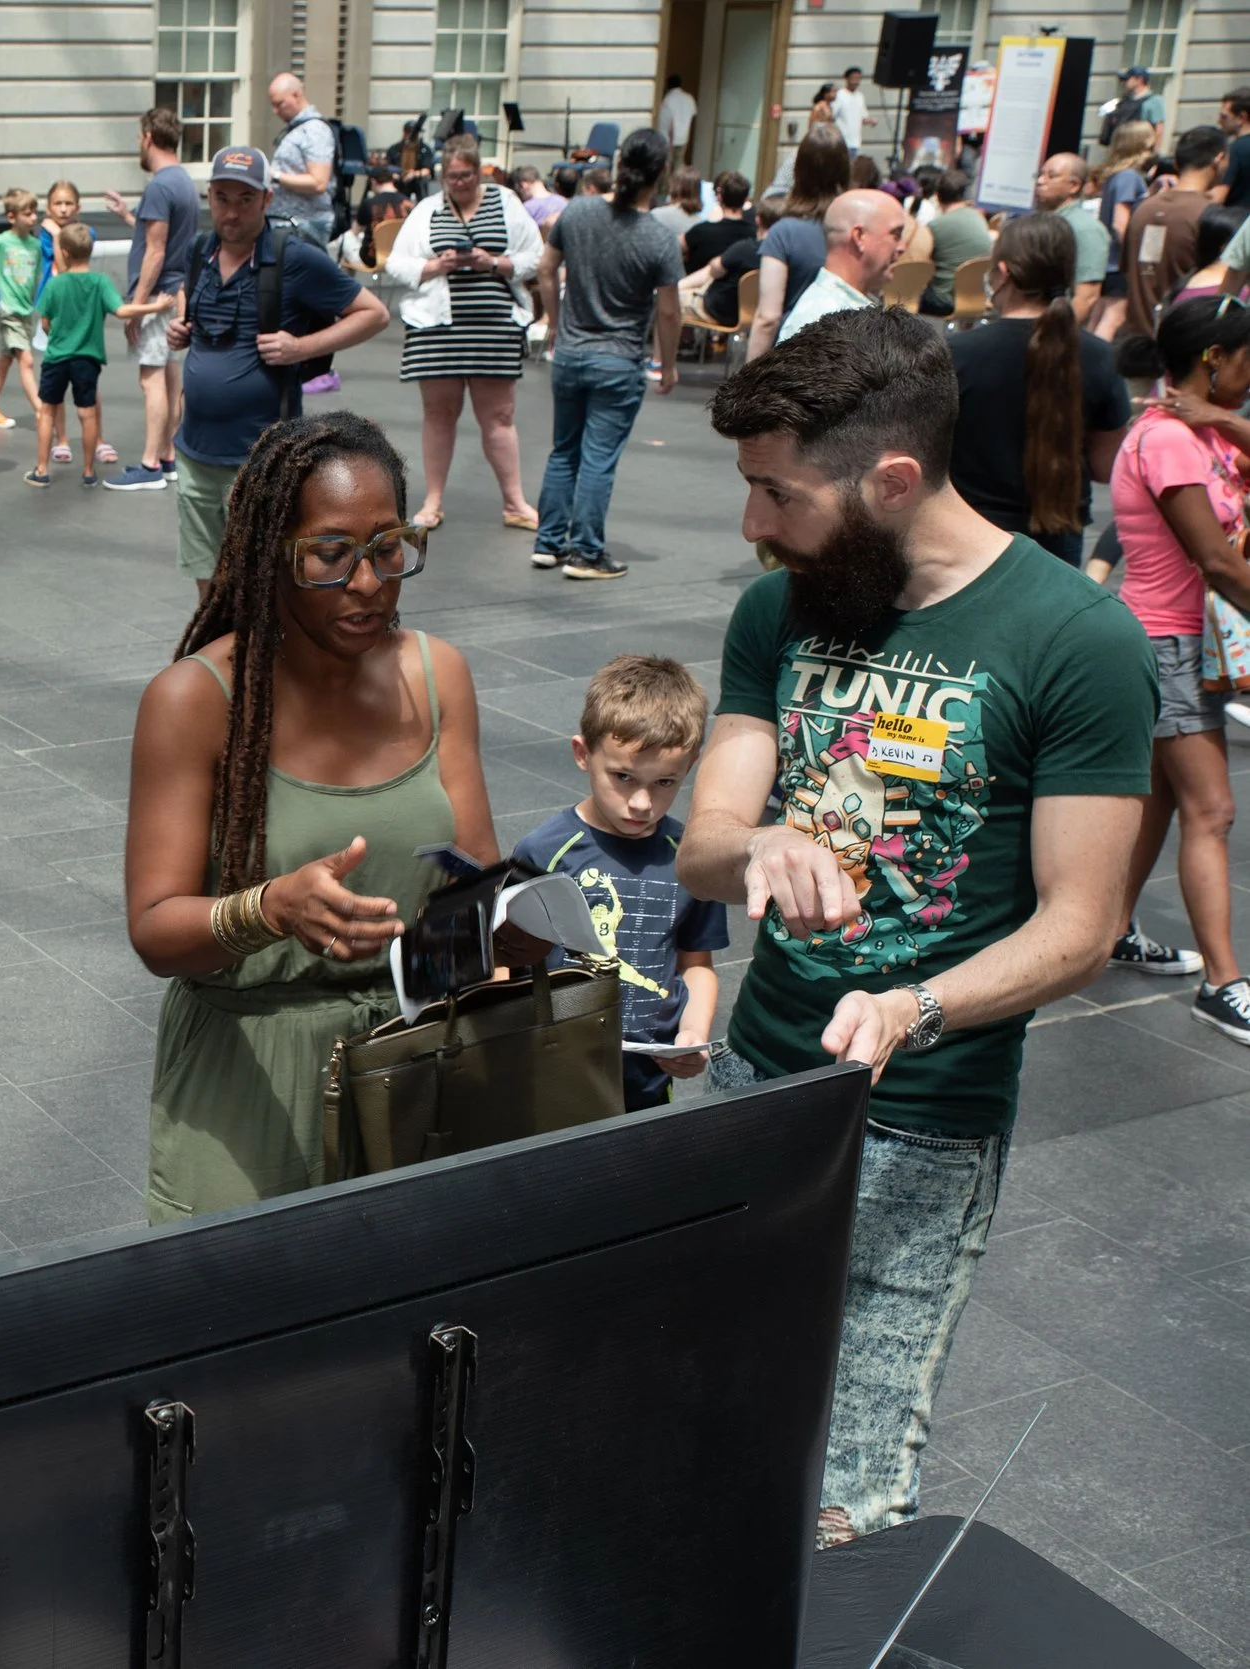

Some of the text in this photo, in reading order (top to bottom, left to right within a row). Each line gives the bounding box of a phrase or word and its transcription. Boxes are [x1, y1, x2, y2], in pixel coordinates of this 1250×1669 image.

[790, 661, 973, 733] TUNIC
[876, 716, 913, 733] hello
[898, 734, 917, 742] name
[881, 745, 915, 760] KEVIN
[599, 922, 609, 936] 8
